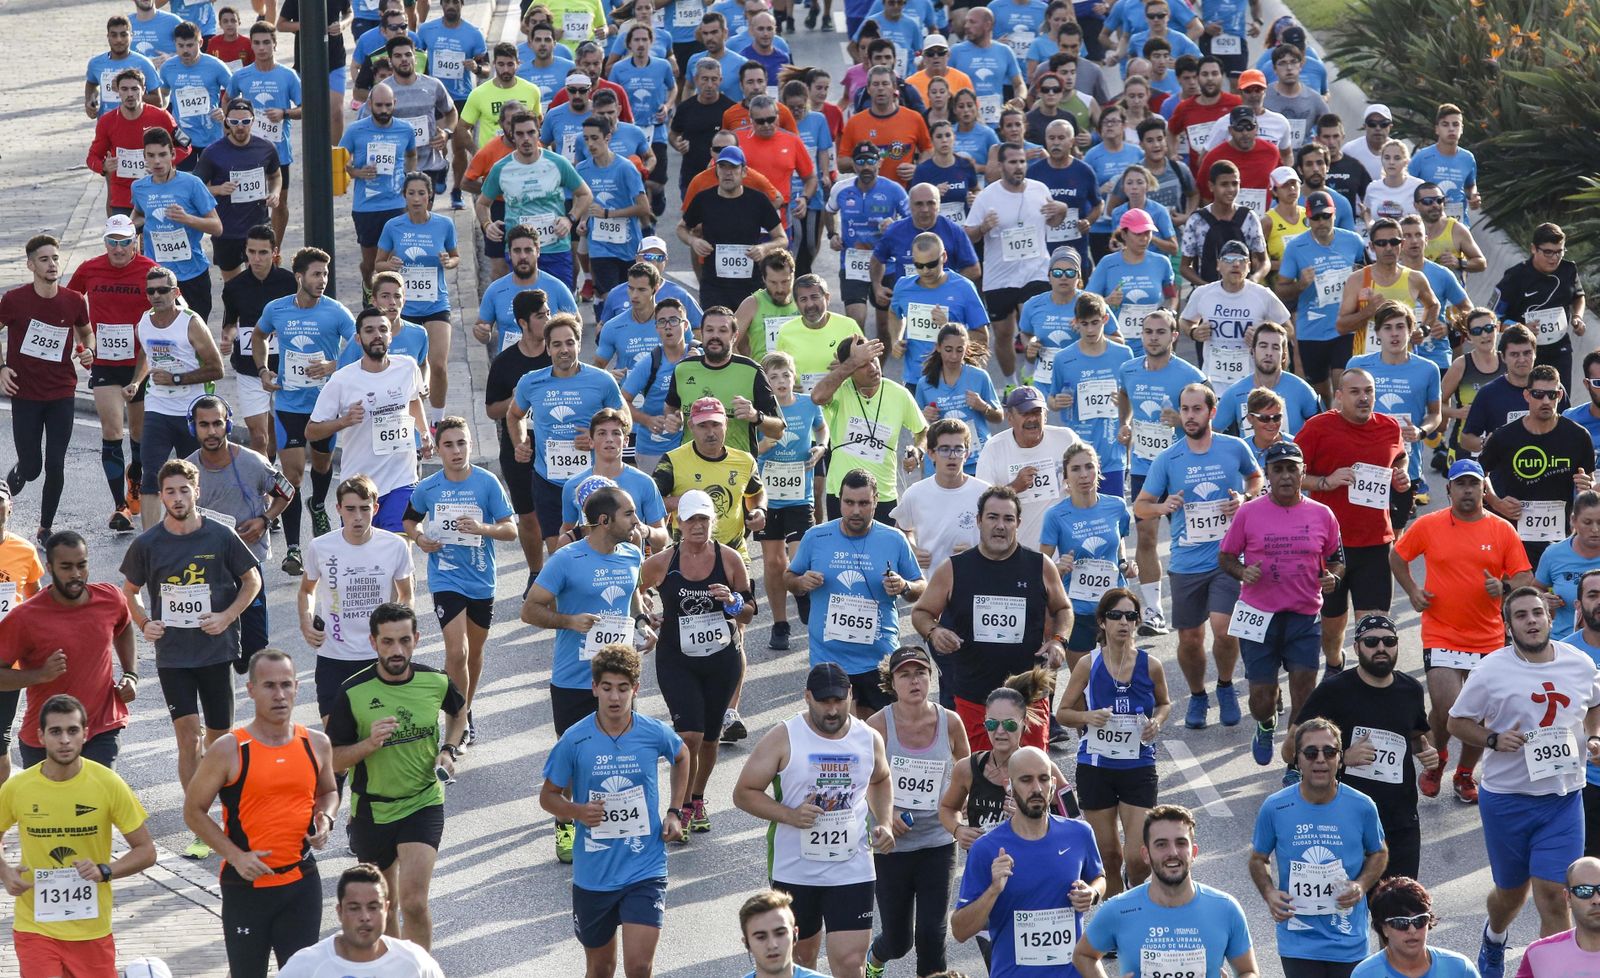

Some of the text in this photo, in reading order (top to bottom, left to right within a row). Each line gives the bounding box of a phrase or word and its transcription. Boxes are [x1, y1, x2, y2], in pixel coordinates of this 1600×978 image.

[438, 60, 460, 69] 9405
[181, 97, 207, 108] 18427
[257, 121, 278, 133] 1836
[122, 159, 145, 169] 6319
[238, 181, 260, 192] 1330
[599, 222, 620, 232] 6936
[155, 241, 187, 252] 13844
[1008, 239, 1033, 250] 1075
[722, 257, 748, 267] 9063
[851, 261, 870, 271] 665
[405, 280, 431, 291] 1365
[1214, 304, 1249, 318] Remo
[32, 334, 59, 349] 2835
[102, 338, 128, 348] 3355
[1216, 361, 1242, 372] 3158
[1085, 394, 1110, 406] 1627
[380, 429, 408, 441] 6513
[1137, 434, 1168, 449] 15303
[551, 455, 587, 468] 13848
[765, 476, 801, 488] 13849
[1352, 479, 1386, 493] 18475
[1190, 515, 1226, 529] 15179
[1526, 516, 1557, 528] 8701
[1079, 574, 1110, 588] 8026
[169, 600, 202, 613] 8490
[342, 599, 382, 607] FUENGIROLA
[831, 613, 873, 630] 15655
[982, 614, 1017, 629] 6630
[1236, 611, 1263, 628] 3788
[595, 631, 626, 644] 8027
[689, 628, 722, 645] 1805
[1097, 729, 1132, 744] 6057
[1534, 744, 1571, 761] 3930
[821, 763, 849, 772] VUELA
[898, 776, 934, 792] 6945
[976, 799, 1004, 809] LIMI
[811, 831, 848, 846] 2121
[41, 886, 92, 904] 13148
[1294, 882, 1332, 898] 1314
[1020, 930, 1072, 948] 15209
